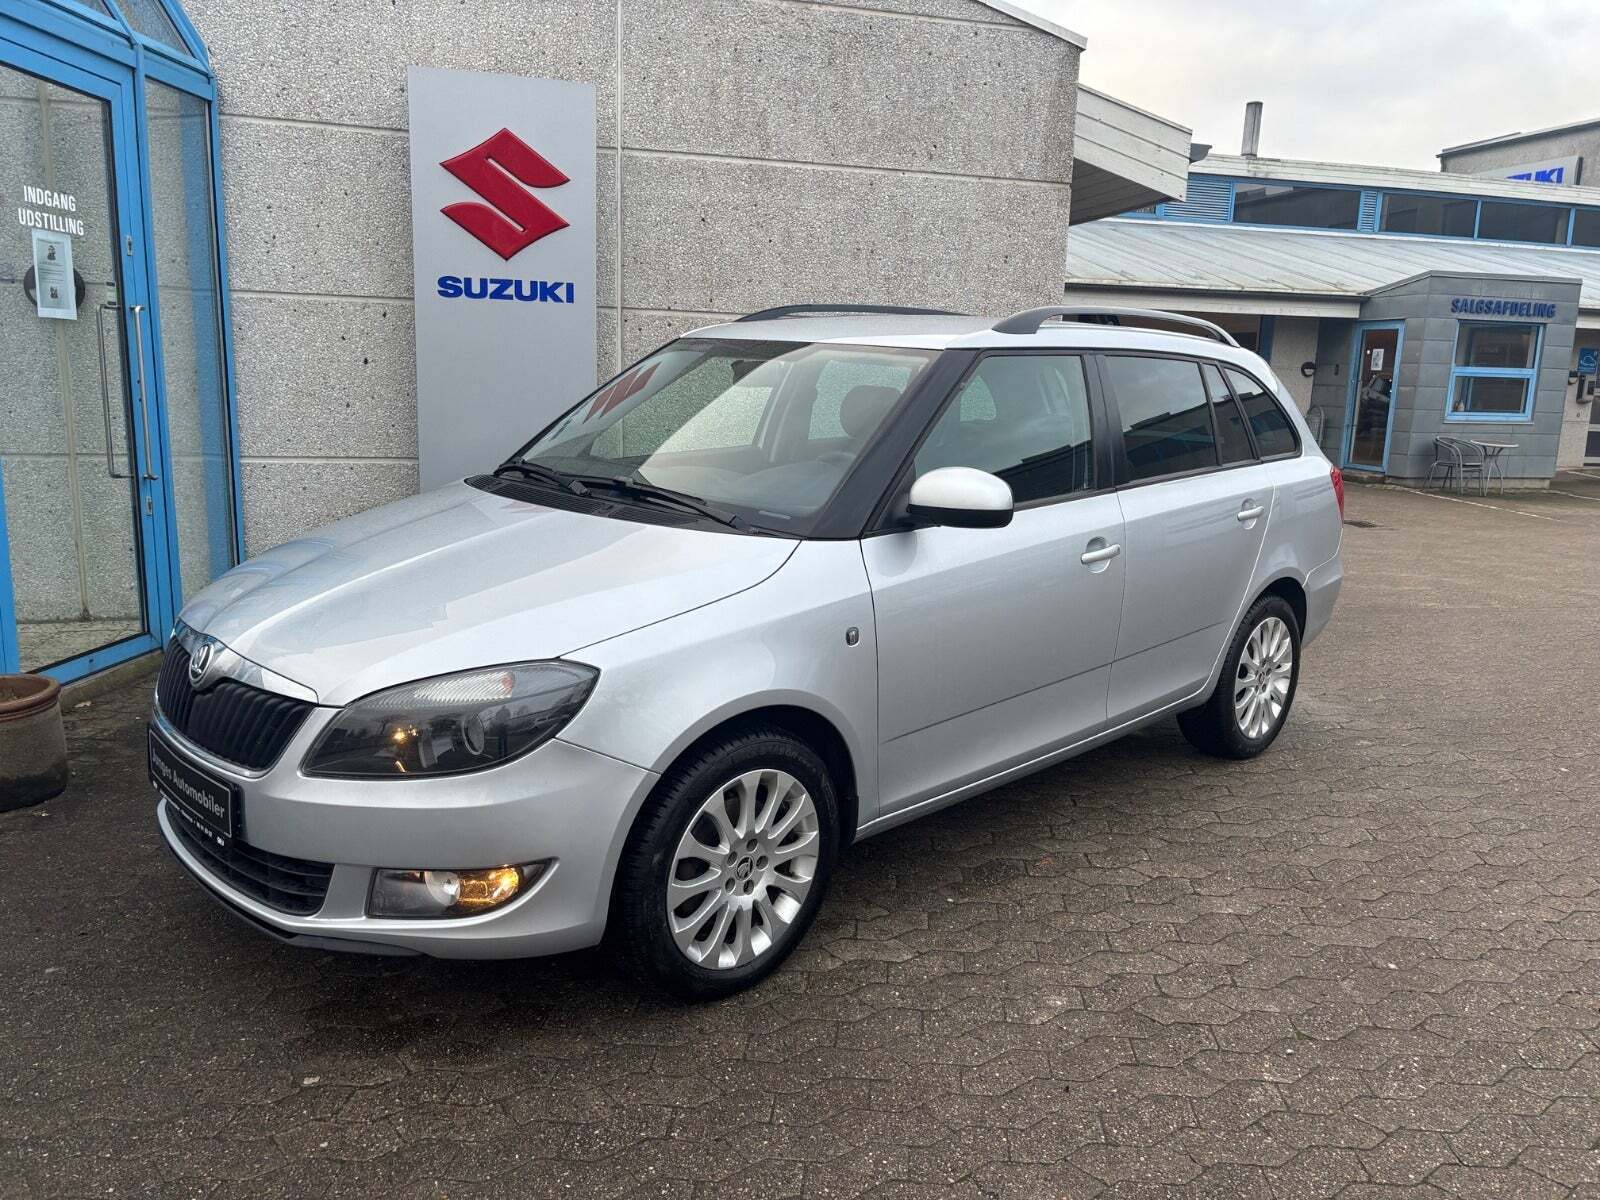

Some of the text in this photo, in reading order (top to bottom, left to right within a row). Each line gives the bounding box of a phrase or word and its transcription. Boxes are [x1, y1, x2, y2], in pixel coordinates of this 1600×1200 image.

[24, 185, 76, 211] INDGANG
[18, 208, 84, 236] UDSTILLING
[437, 275, 575, 304] SUZUKI
[1451, 298, 1556, 318] SALGSAFDELING
[173, 771, 225, 818] Automobiler
